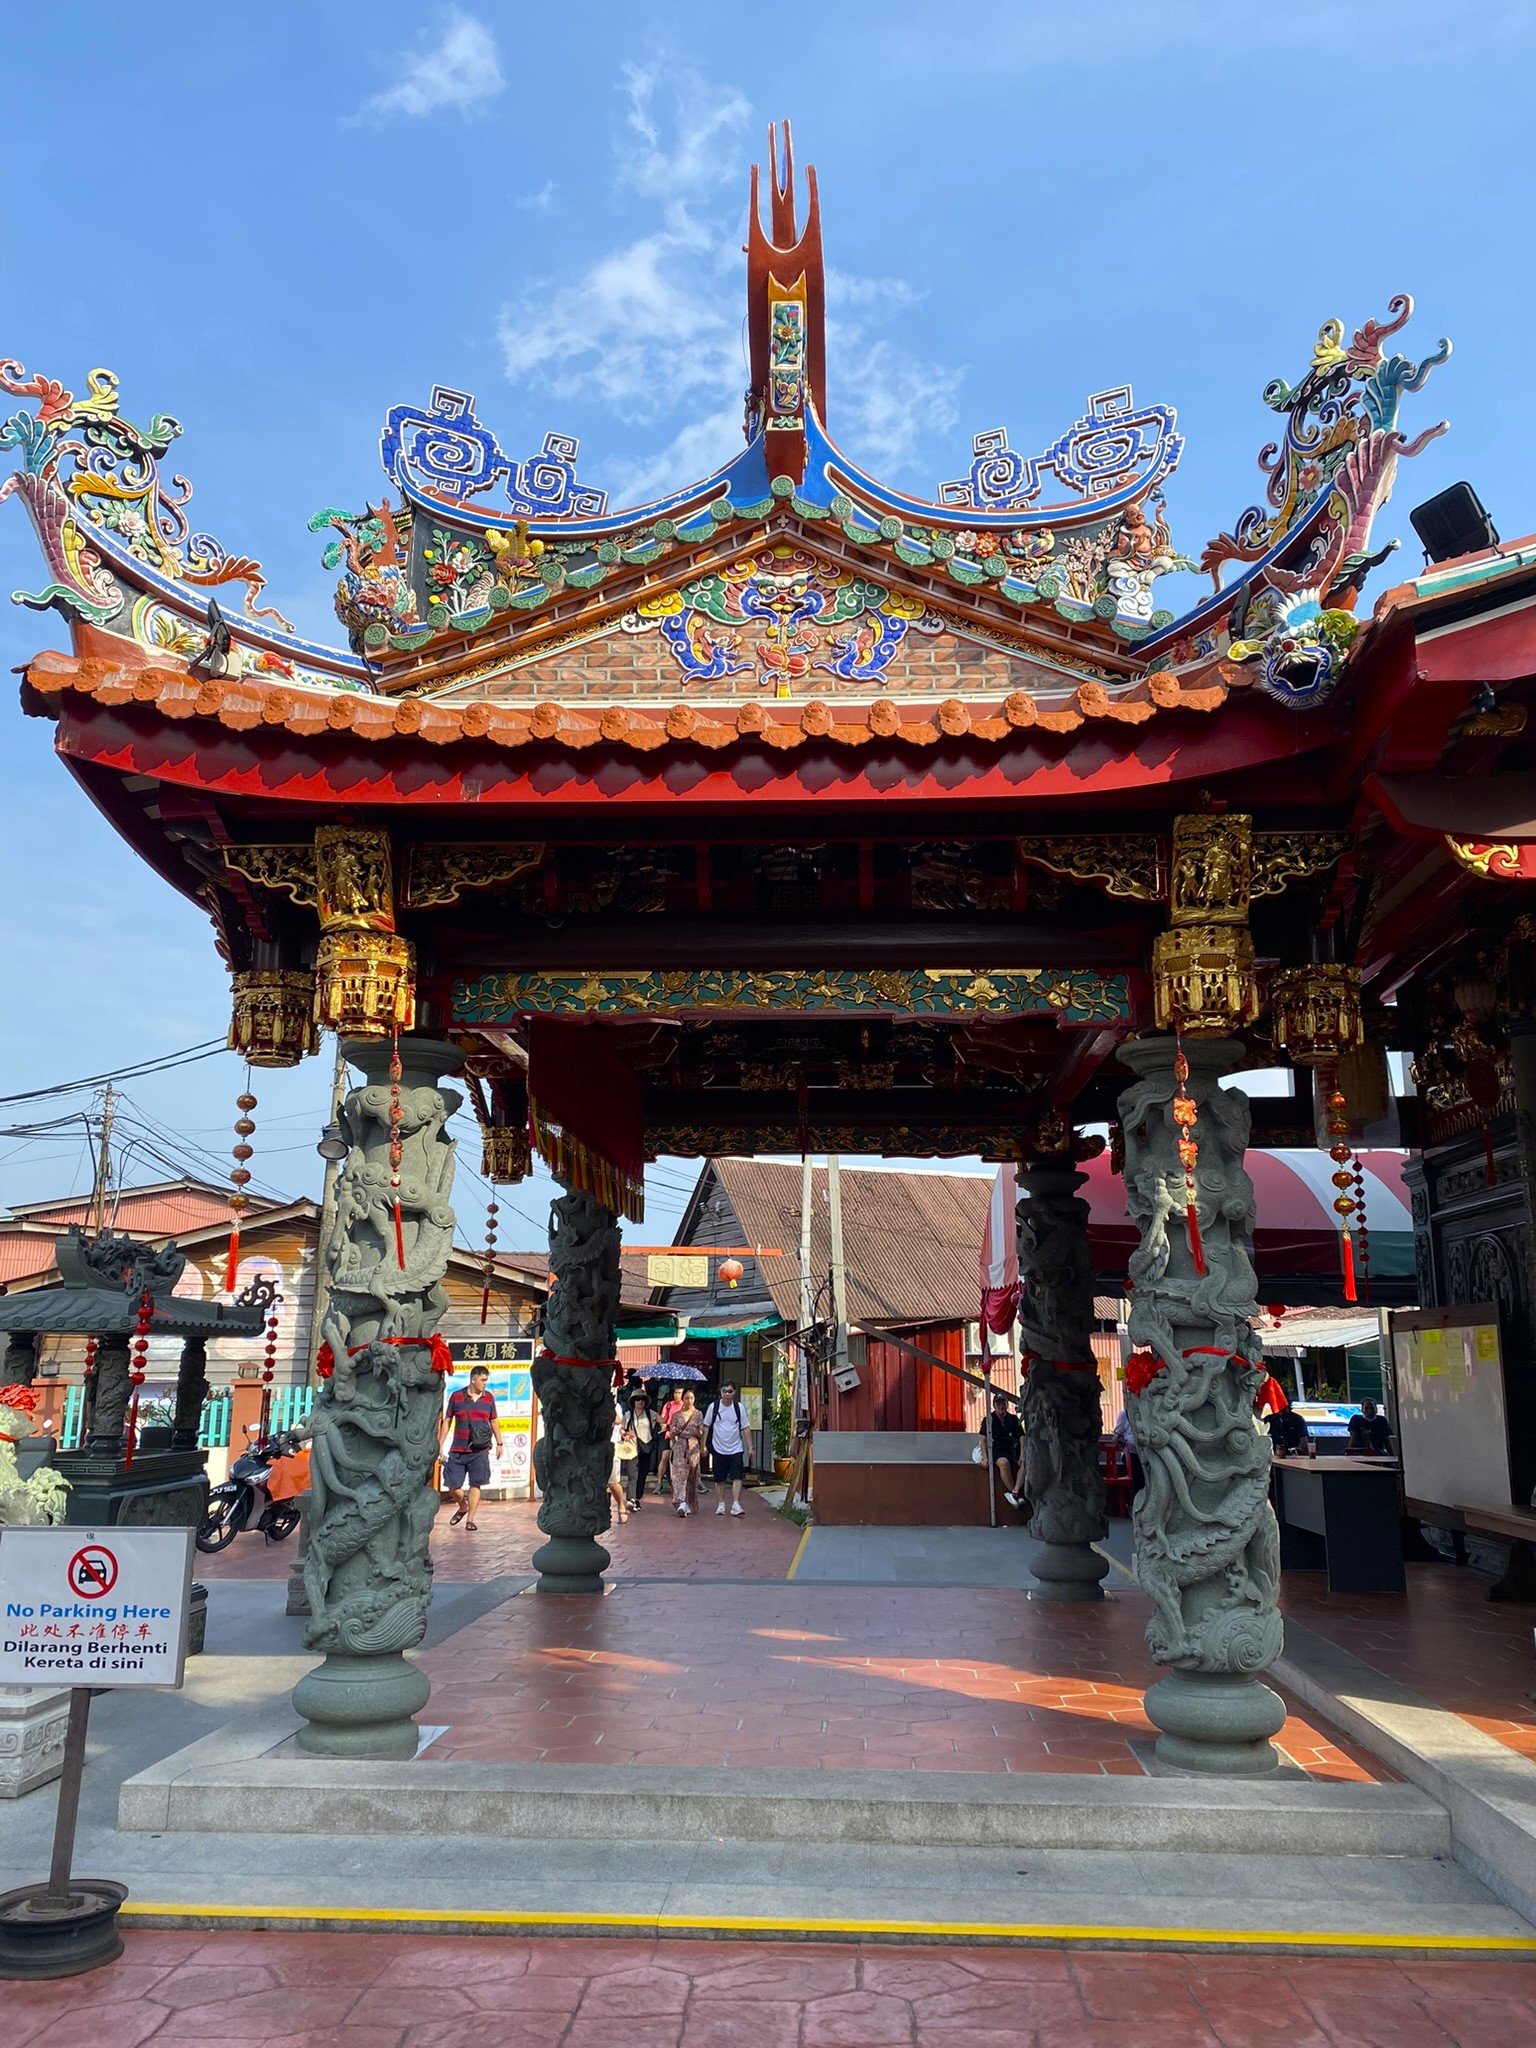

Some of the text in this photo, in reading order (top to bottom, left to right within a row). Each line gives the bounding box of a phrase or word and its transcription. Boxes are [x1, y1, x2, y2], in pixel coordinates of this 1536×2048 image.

[463, 1342, 518, 1360] 姓周橋
[6, 1604, 171, 1621] No Parking Here
[20, 1623, 152, 1641] 此处不准停车
[4, 1641, 168, 1656] Dilarang Berhenti
[24, 1656, 144, 1669] Kereta di sini
